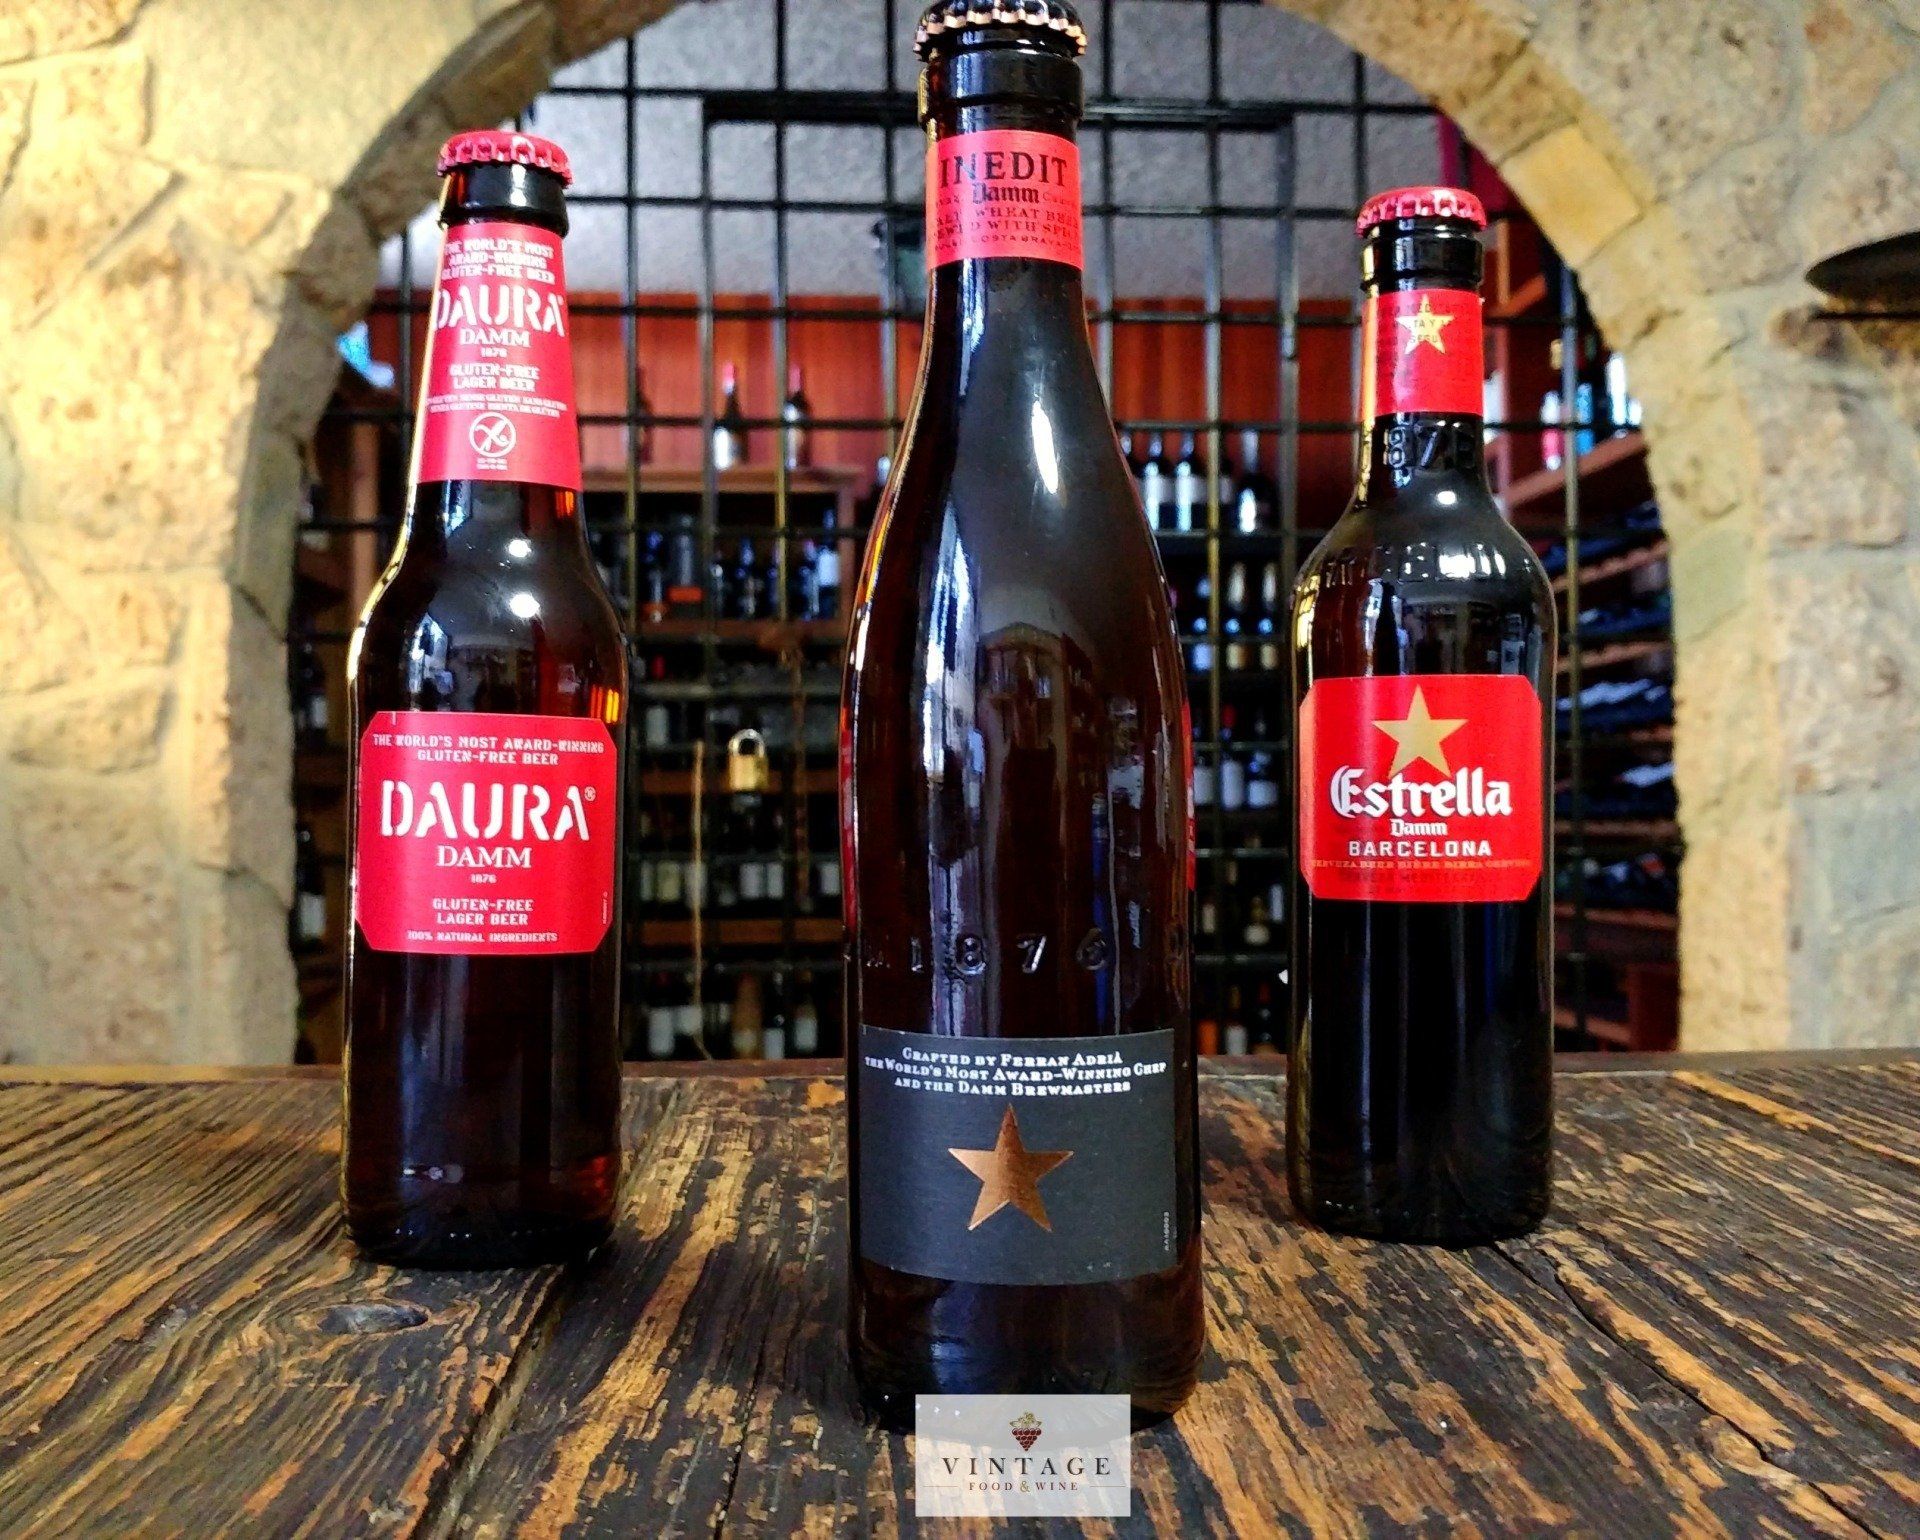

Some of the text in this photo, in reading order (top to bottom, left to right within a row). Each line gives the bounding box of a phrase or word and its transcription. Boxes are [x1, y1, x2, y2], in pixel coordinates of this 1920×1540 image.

[940, 151, 1068, 188] INEDIT
[972, 182, 1039, 204] Damm
[433, 284, 566, 338] DAURA
[459, 328, 531, 348] DAMM
[372, 733, 605, 754] THE WORLD'S MOST AWARD-WINNING
[417, 751, 559, 766] GLUTEN-FREE BEER
[1329, 764, 1513, 819] Estrella
[1389, 818, 1449, 837] Damm
[436, 845, 533, 869] DAMM
[1347, 839, 1493, 858] BARCELONA
[469, 872, 498, 884] 1876
[431, 897, 534, 912] GLUTEN-FREE
[436, 912, 529, 926] LAGER BEER
[406, 929, 559, 943] 100% NATURAL INGREDIENTS
[945, 1065, 990, 1081] MOST
[992, 1066, 1132, 1082] AWARD-WINNING
[957, 1080, 1008, 1097] DAMM
[1010, 1081, 1132, 1097] BREWMASTERS
